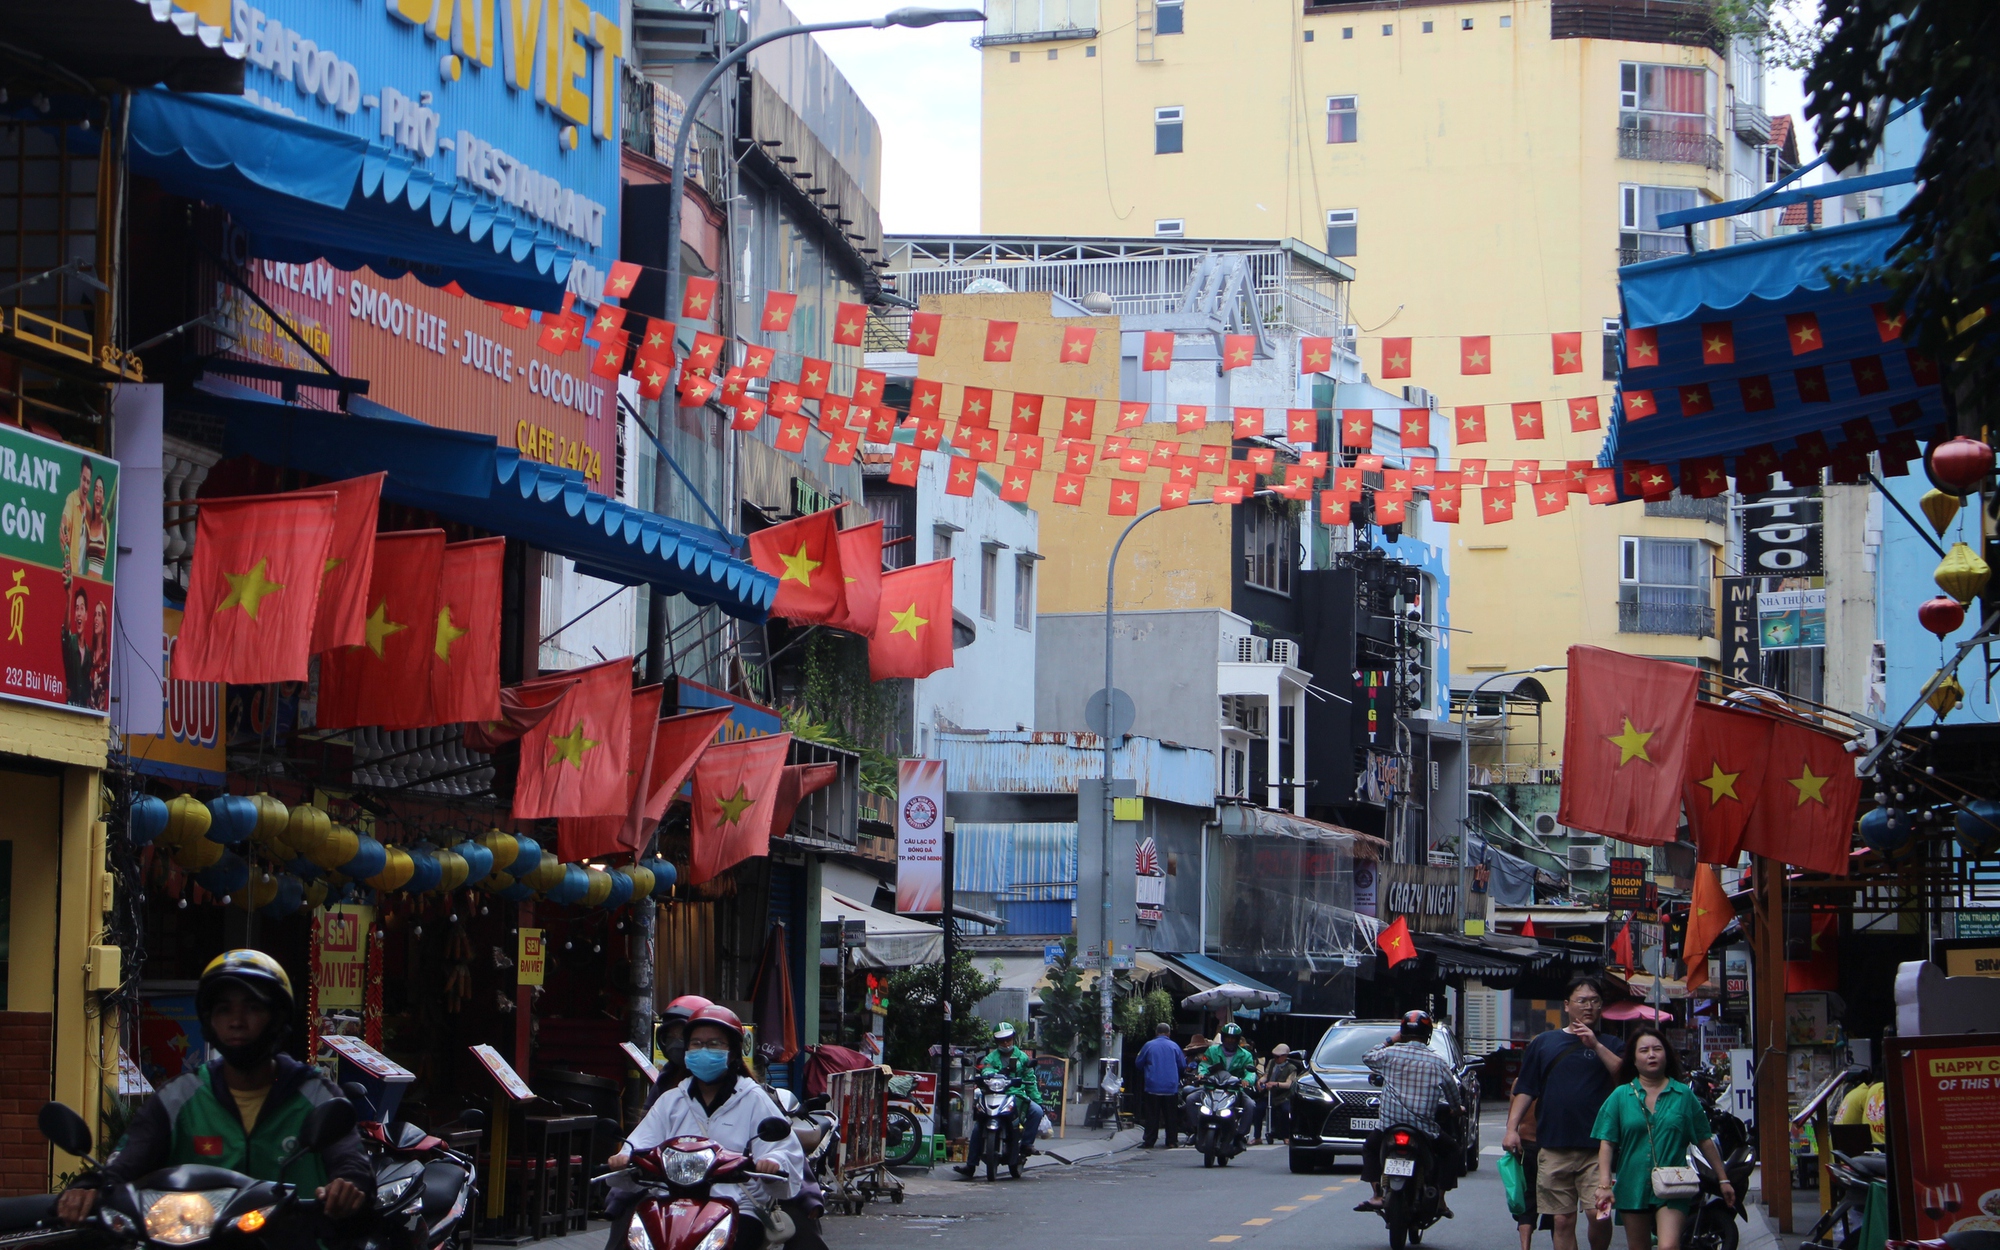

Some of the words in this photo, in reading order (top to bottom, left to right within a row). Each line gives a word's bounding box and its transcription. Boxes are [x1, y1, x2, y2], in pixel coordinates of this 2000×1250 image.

[233, 0, 360, 114] SEAFOOD
[381, 87, 440, 158] PHỞ
[456, 130, 606, 248] RESTAURANT
[263, 258, 333, 306] CREAM
[350, 279, 447, 355] SMOOTHIE
[462, 329, 513, 383] JUICE
[528, 359, 604, 420] COCONUT
[516, 419, 555, 464] CAFE
[559, 435, 601, 482] 24/24
[2, 496, 47, 544] GÒN
[1760, 595, 1780, 606] NHÀ
[5, 666, 24, 686] 232
[25, 669, 41, 690] Bùi
[43, 672, 64, 695] Viện
[917, 838, 928, 846] LẠC
[928, 838, 937, 846] BỘ
[1611, 860, 1643, 876] BBQ
[1611, 878, 1642, 887] SAIGON
[1388, 881, 1423, 914] CRAZY
[1425, 884, 1459, 916] NIGHT
[1613, 887, 1639, 896] NIGHT
[327, 918, 353, 946] SEN
[526, 939, 539, 953] SEN
[336, 955, 365, 996] VIỆT
[1935, 1061, 1983, 1073] HAPPY
[1938, 1079, 1957, 1091] OF
[1960, 1078, 1990, 1090] THIS
[1352, 1120, 1366, 1129] 51H
